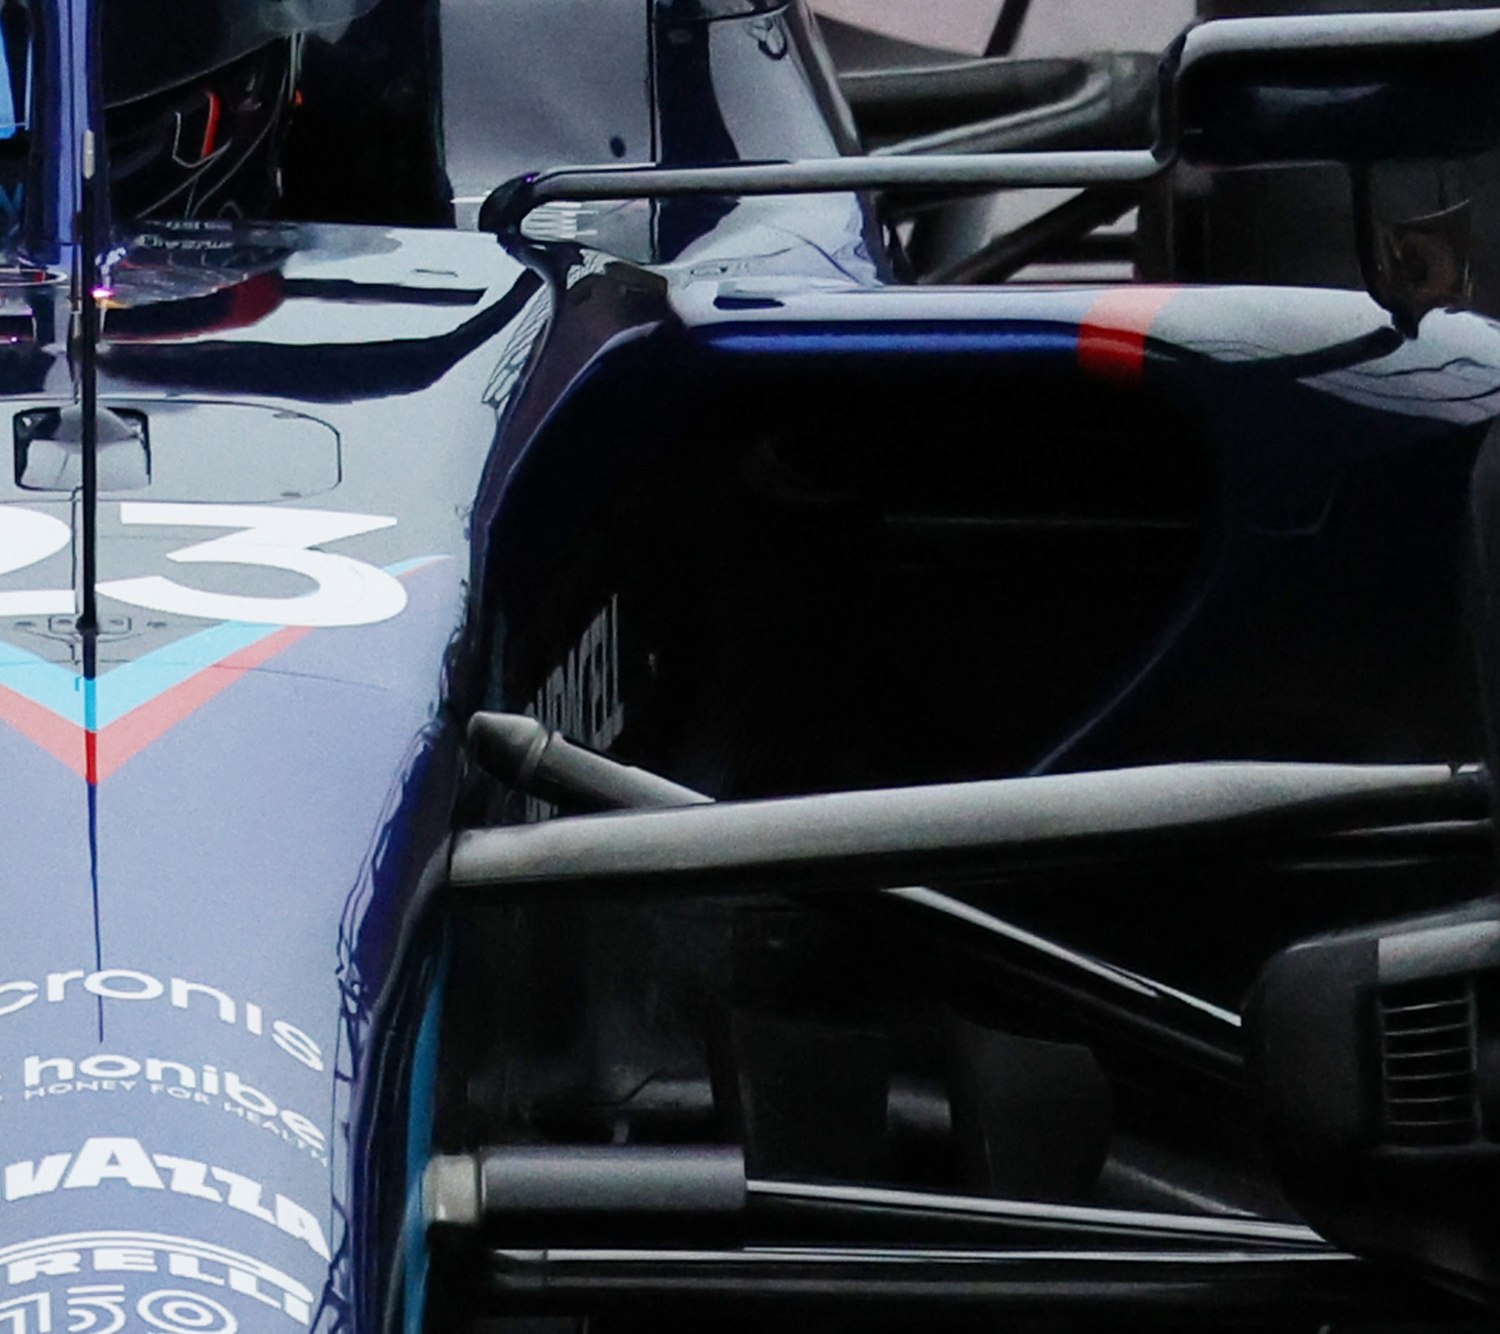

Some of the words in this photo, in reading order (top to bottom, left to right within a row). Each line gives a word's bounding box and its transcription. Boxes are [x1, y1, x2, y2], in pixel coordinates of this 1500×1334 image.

[23, 1054, 327, 1149] honibe
[23, 1080, 136, 1100] HONEY
[150, 1083, 209, 1106] FOR
[221, 1102, 328, 1167] HEALTH
